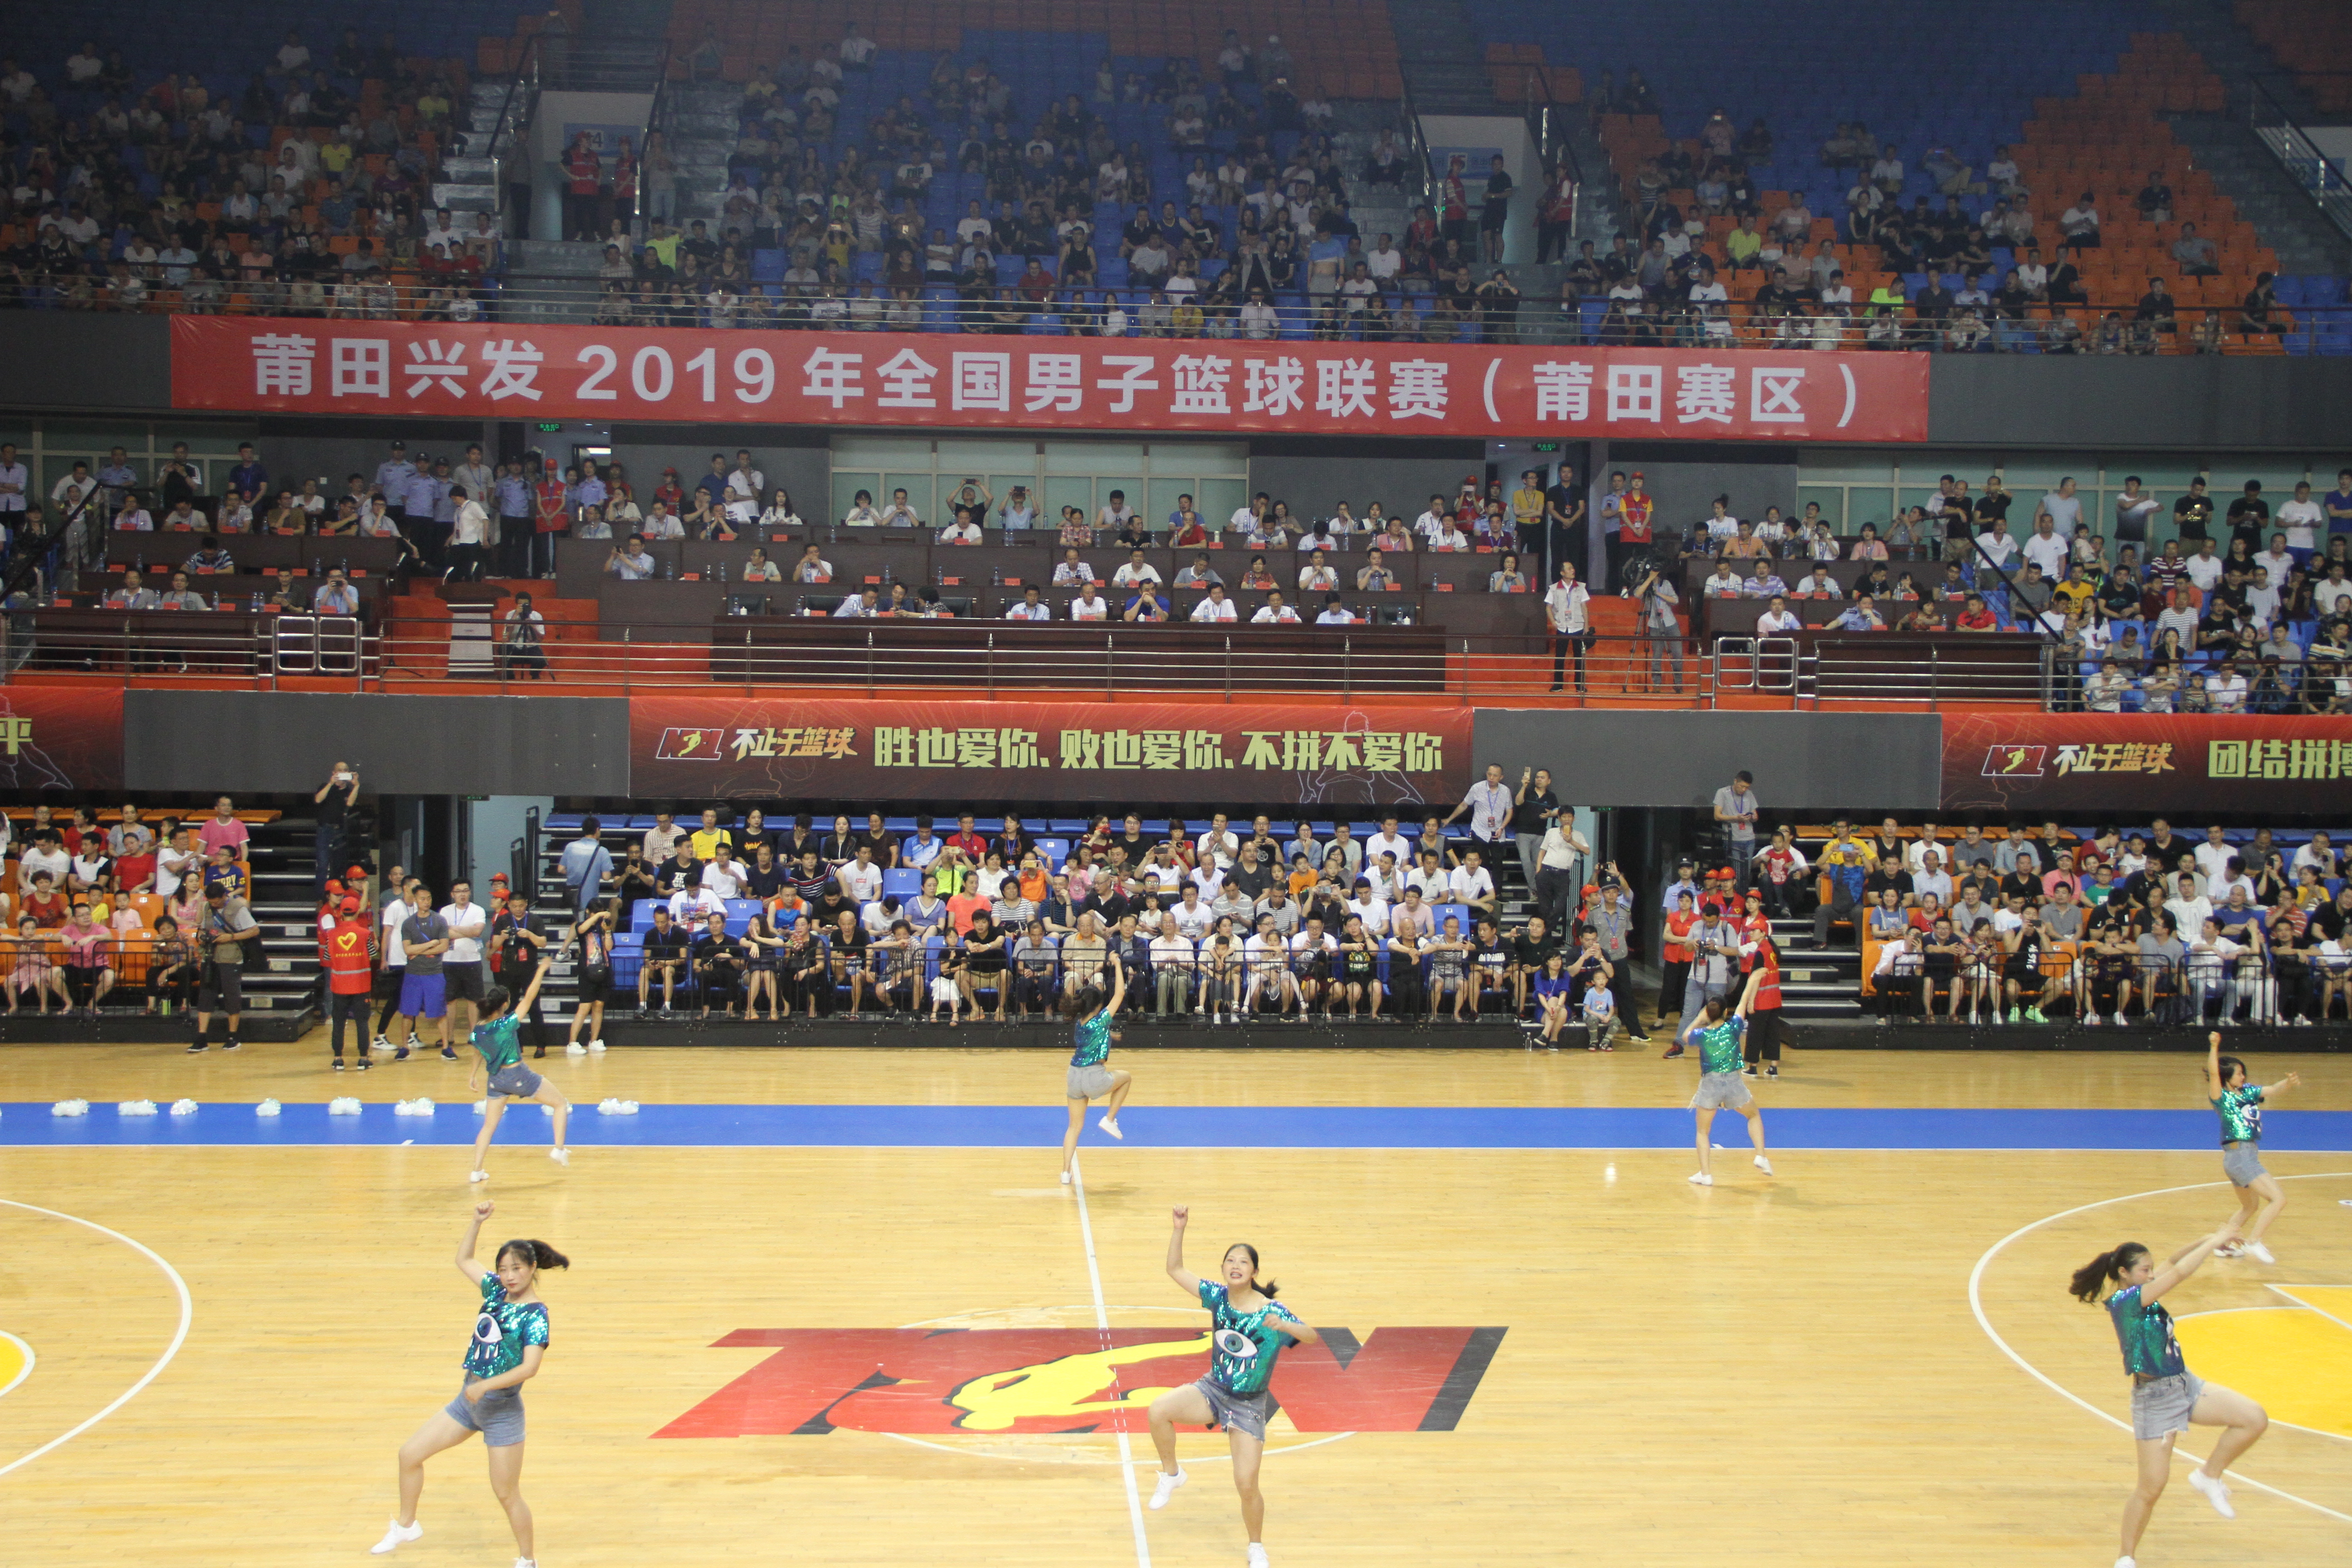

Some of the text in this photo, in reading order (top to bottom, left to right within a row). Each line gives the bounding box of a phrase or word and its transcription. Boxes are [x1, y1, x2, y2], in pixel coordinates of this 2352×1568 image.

[730, 726, 858, 761] 不止于篮球
[2053, 742, 2175, 776] 不止于篮球
